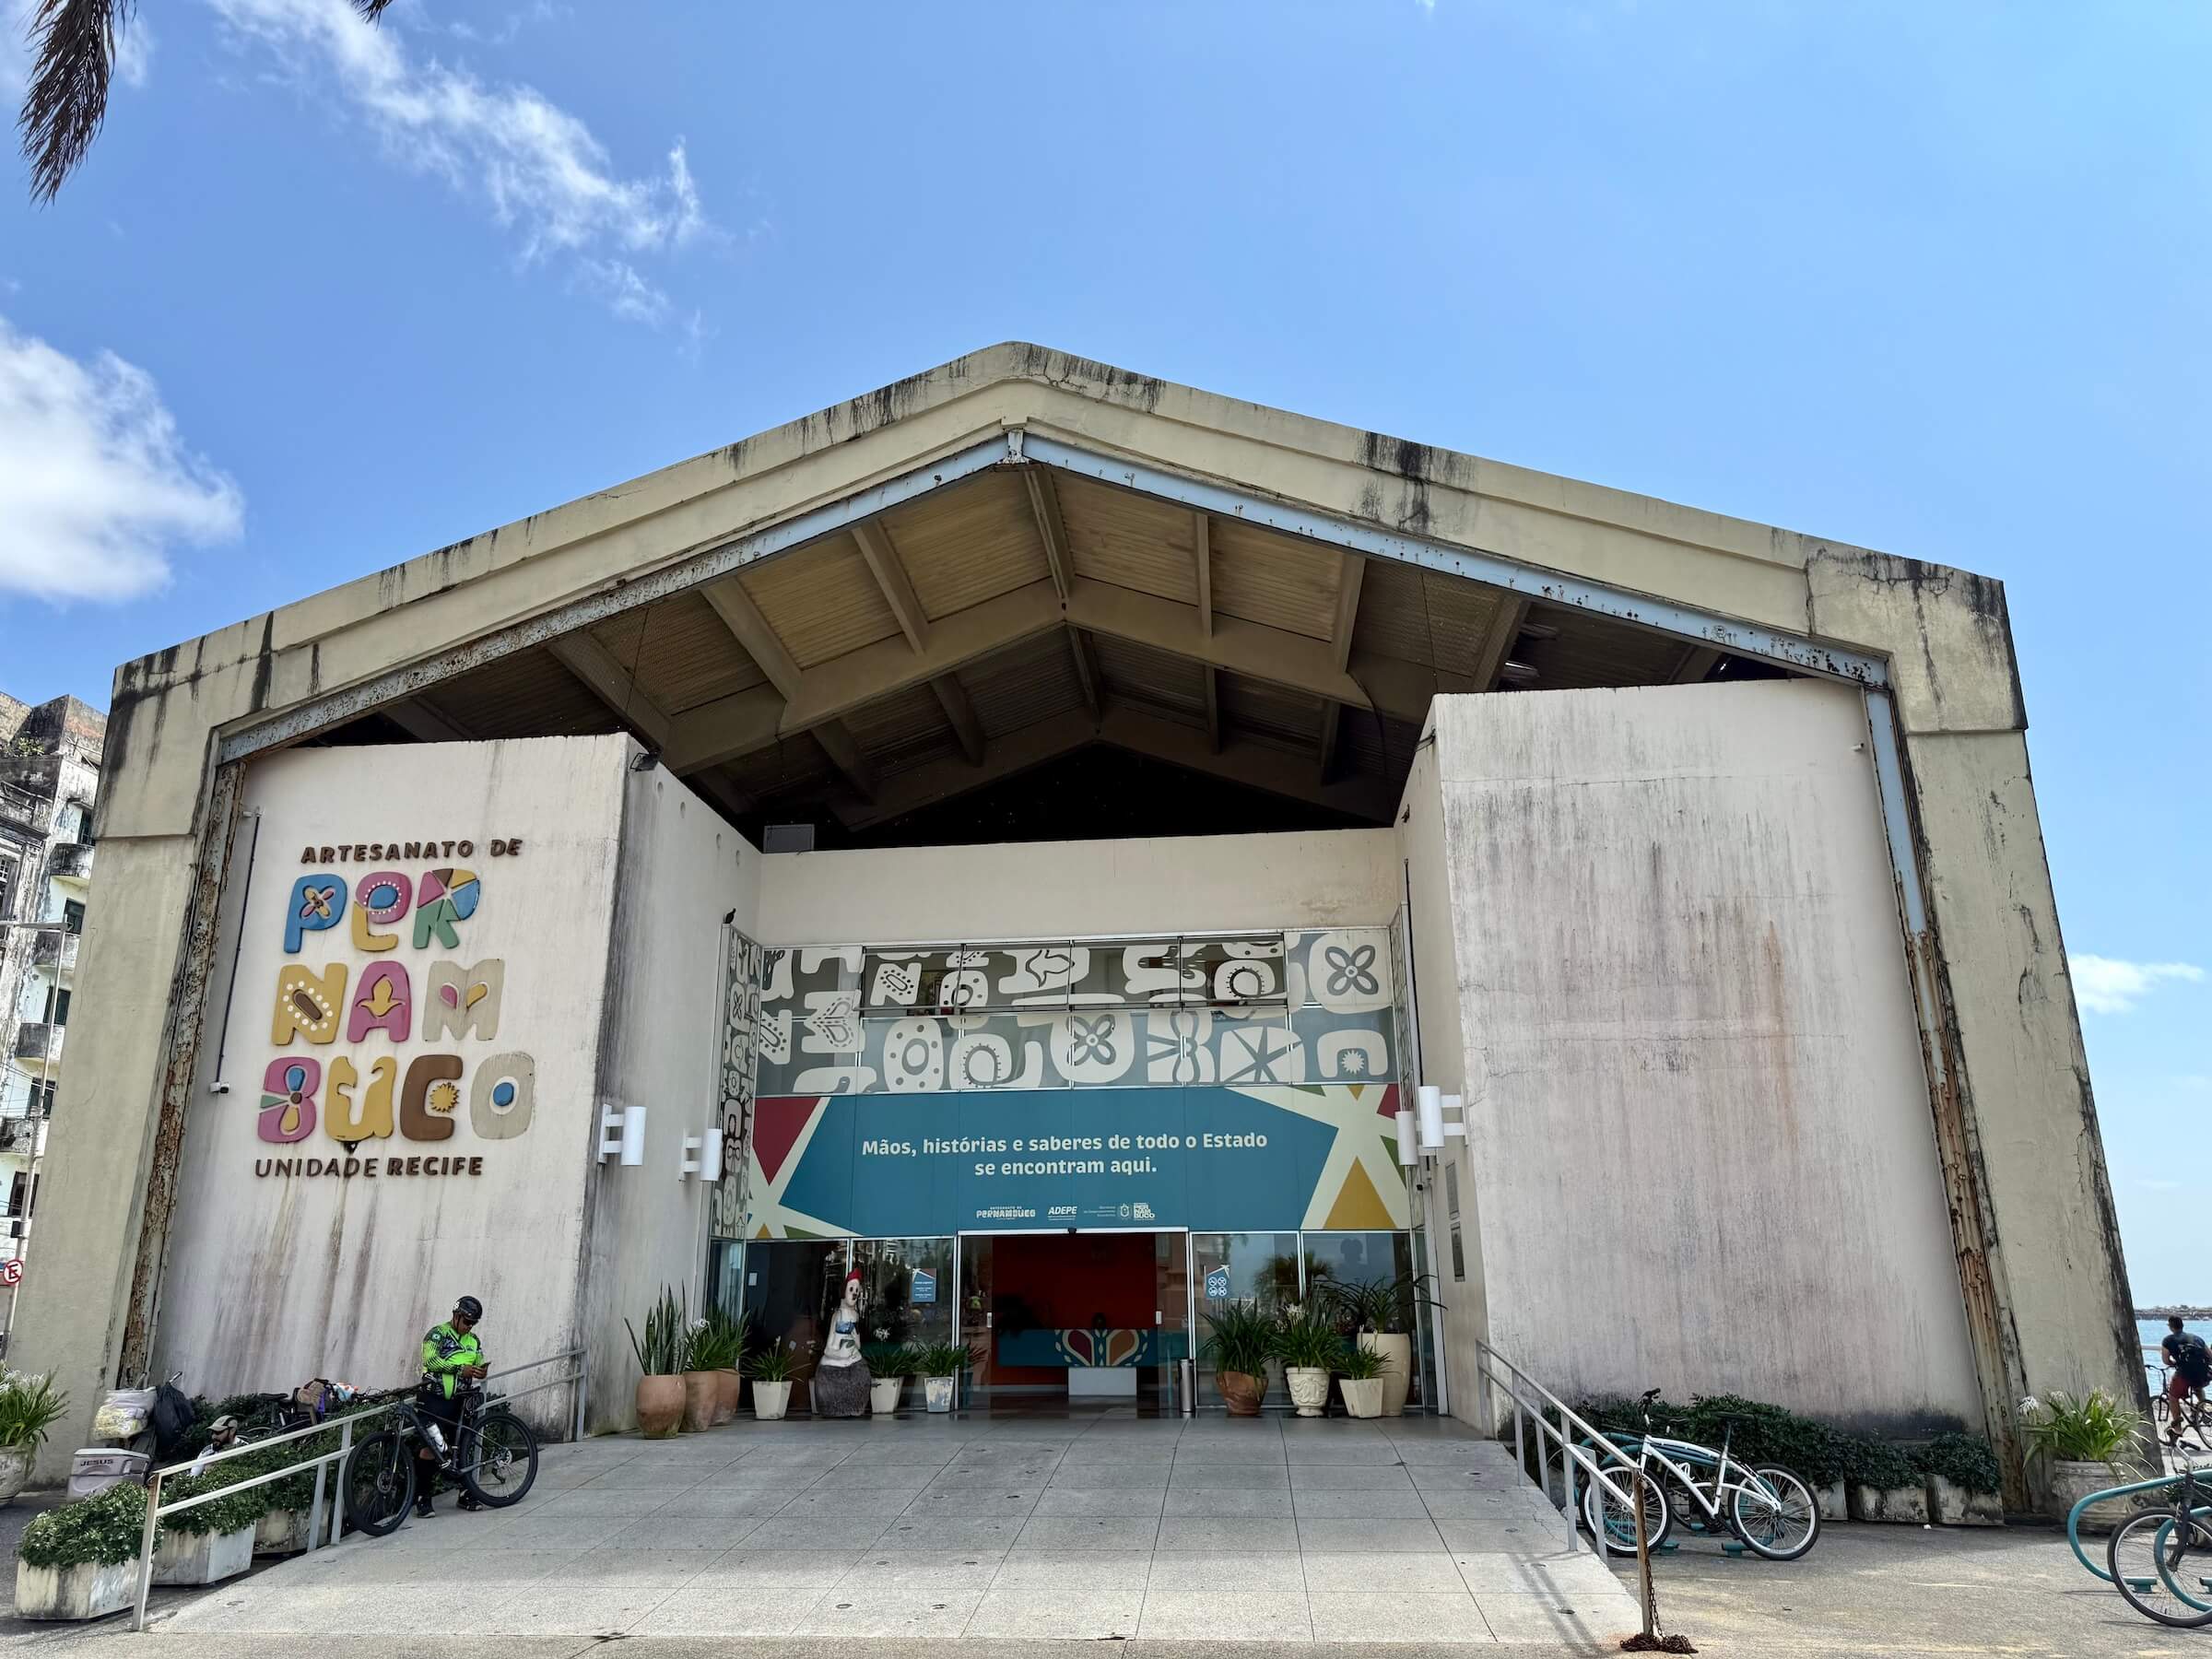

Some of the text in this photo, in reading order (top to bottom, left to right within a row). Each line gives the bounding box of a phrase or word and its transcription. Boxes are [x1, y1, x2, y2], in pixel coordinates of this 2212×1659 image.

[300, 838, 524, 864] ARTESANATO DE
[271, 959, 505, 1046] NAM
[257, 1052, 536, 1143] BUCO
[862, 1132, 1268, 1158] Mãos, histórias e saberes de todo o Estado
[254, 1157, 484, 1179] UNIDADE RECIFE
[974, 1156, 1158, 1176] se encontram aqui.
[1048, 1206, 1077, 1216] ADEPE
